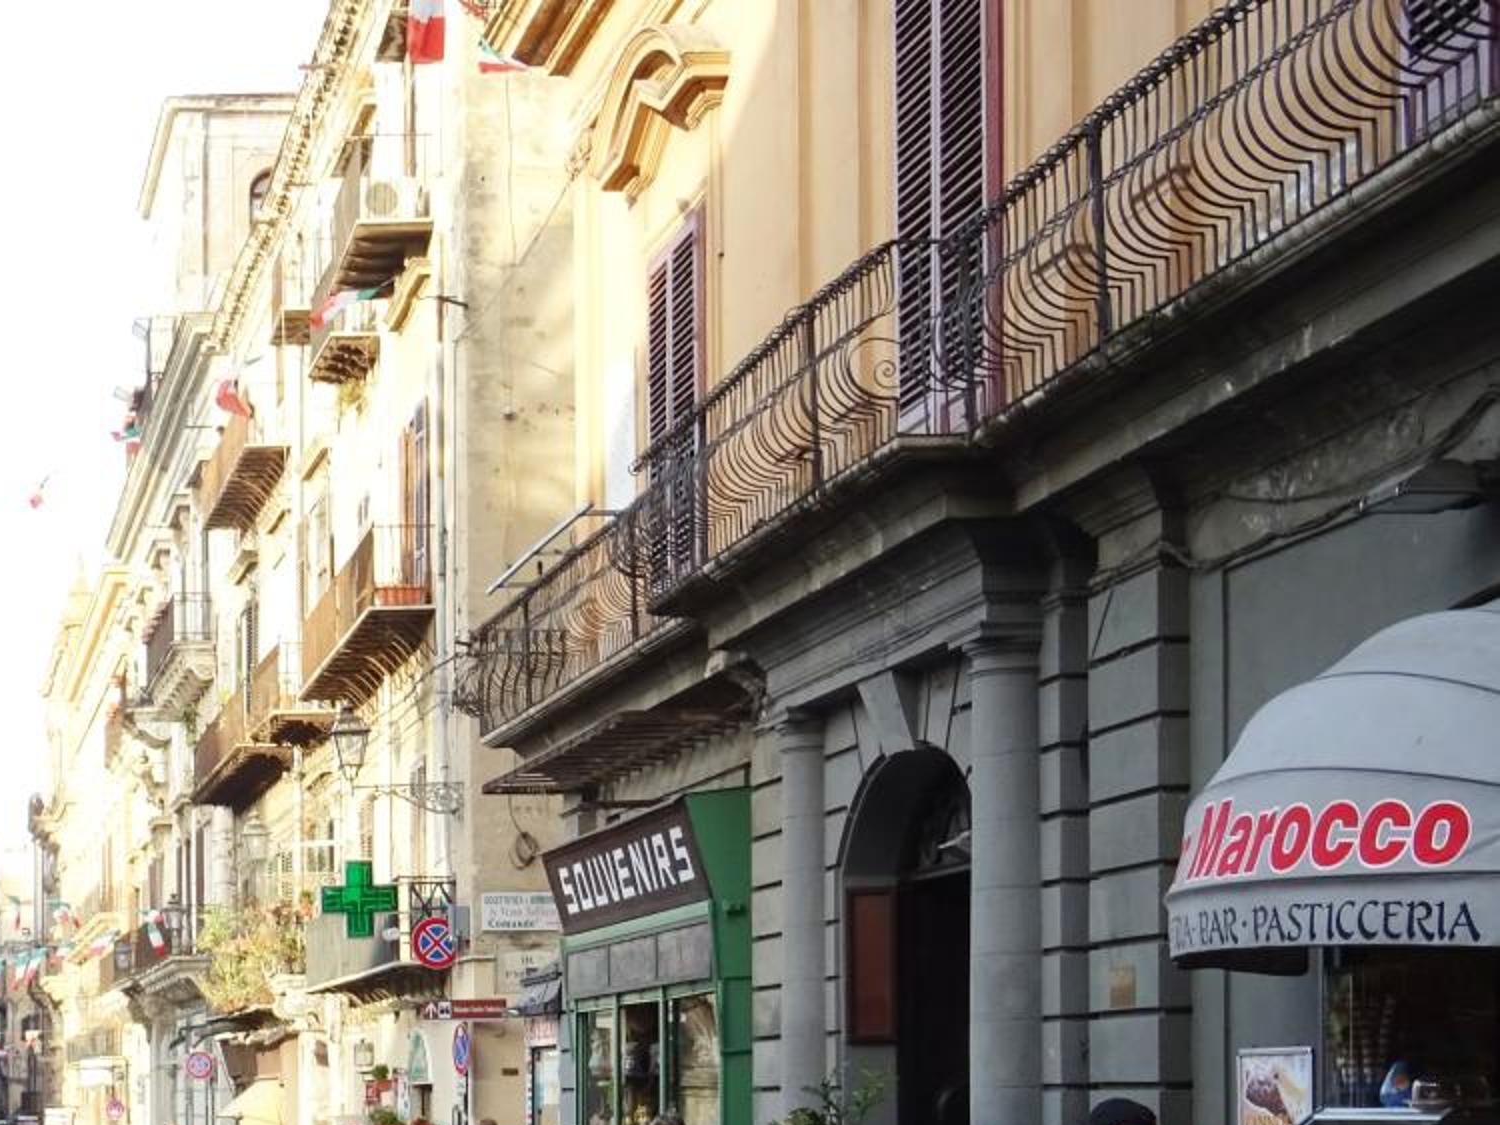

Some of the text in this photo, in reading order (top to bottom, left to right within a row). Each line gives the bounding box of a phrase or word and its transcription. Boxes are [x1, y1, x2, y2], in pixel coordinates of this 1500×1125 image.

[558, 825, 696, 915] SOUVENIRS
[1185, 798, 1472, 880] Marocco
[1252, 900, 1481, 943] PASTICCERIA
